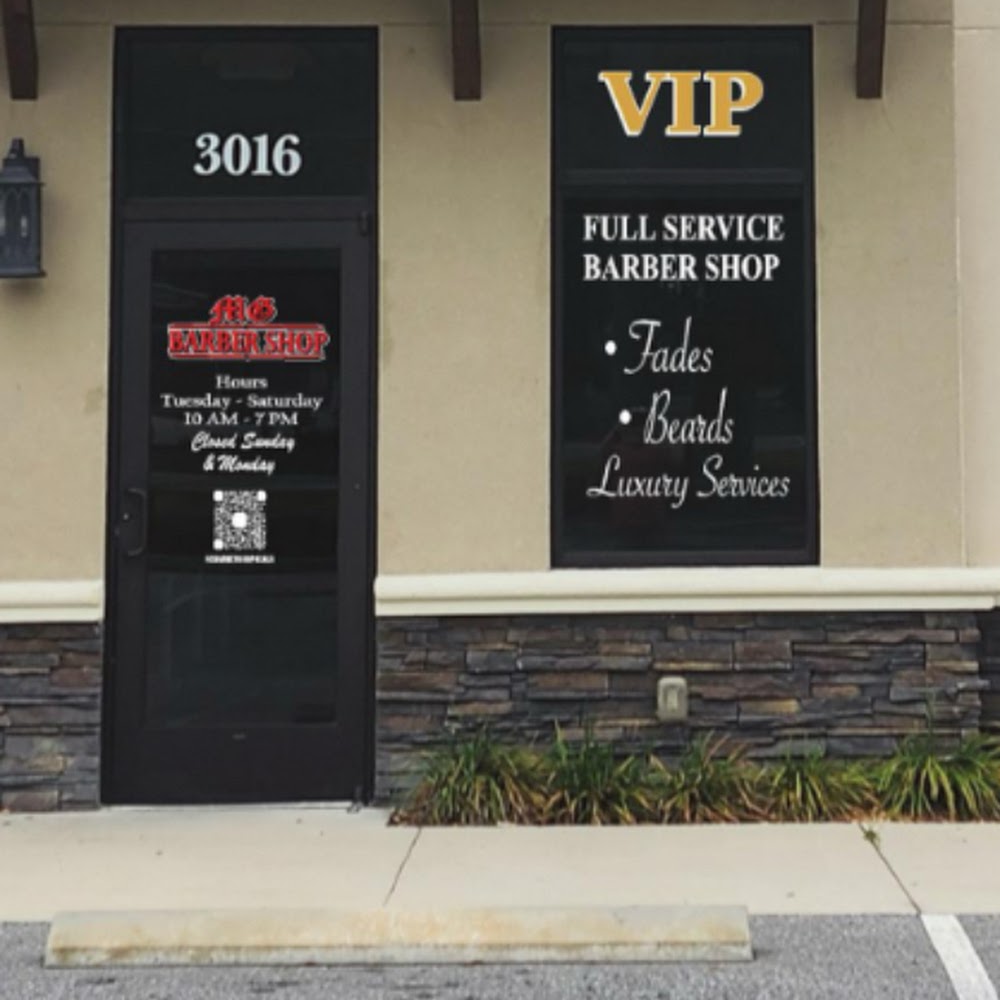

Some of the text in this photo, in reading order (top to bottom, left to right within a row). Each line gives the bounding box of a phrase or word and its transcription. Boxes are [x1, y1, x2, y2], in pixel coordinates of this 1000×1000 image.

[598, 70, 764, 136] VIP
[193, 132, 302, 176] 3016
[583, 214, 785, 241] FULL SERVICE
[583, 253, 780, 281] BARBER SHOP
[208, 295, 278, 326] MG
[168, 329, 331, 354] BARBER SHOP
[624, 316, 714, 374] Fades
[215, 374, 269, 389] Hours
[160, 392, 231, 410] Tuesday
[246, 392, 324, 411] Saturday
[184, 411, 203, 425] 10
[206, 411, 239, 425] AM
[254, 411, 266, 425] 7
[268, 411, 299, 425] PM
[643, 387, 734, 444] Beards
[190, 431, 295, 453] Closed Sunday
[217, 454, 276, 476] Monday
[586, 454, 790, 509] Luxury Services
